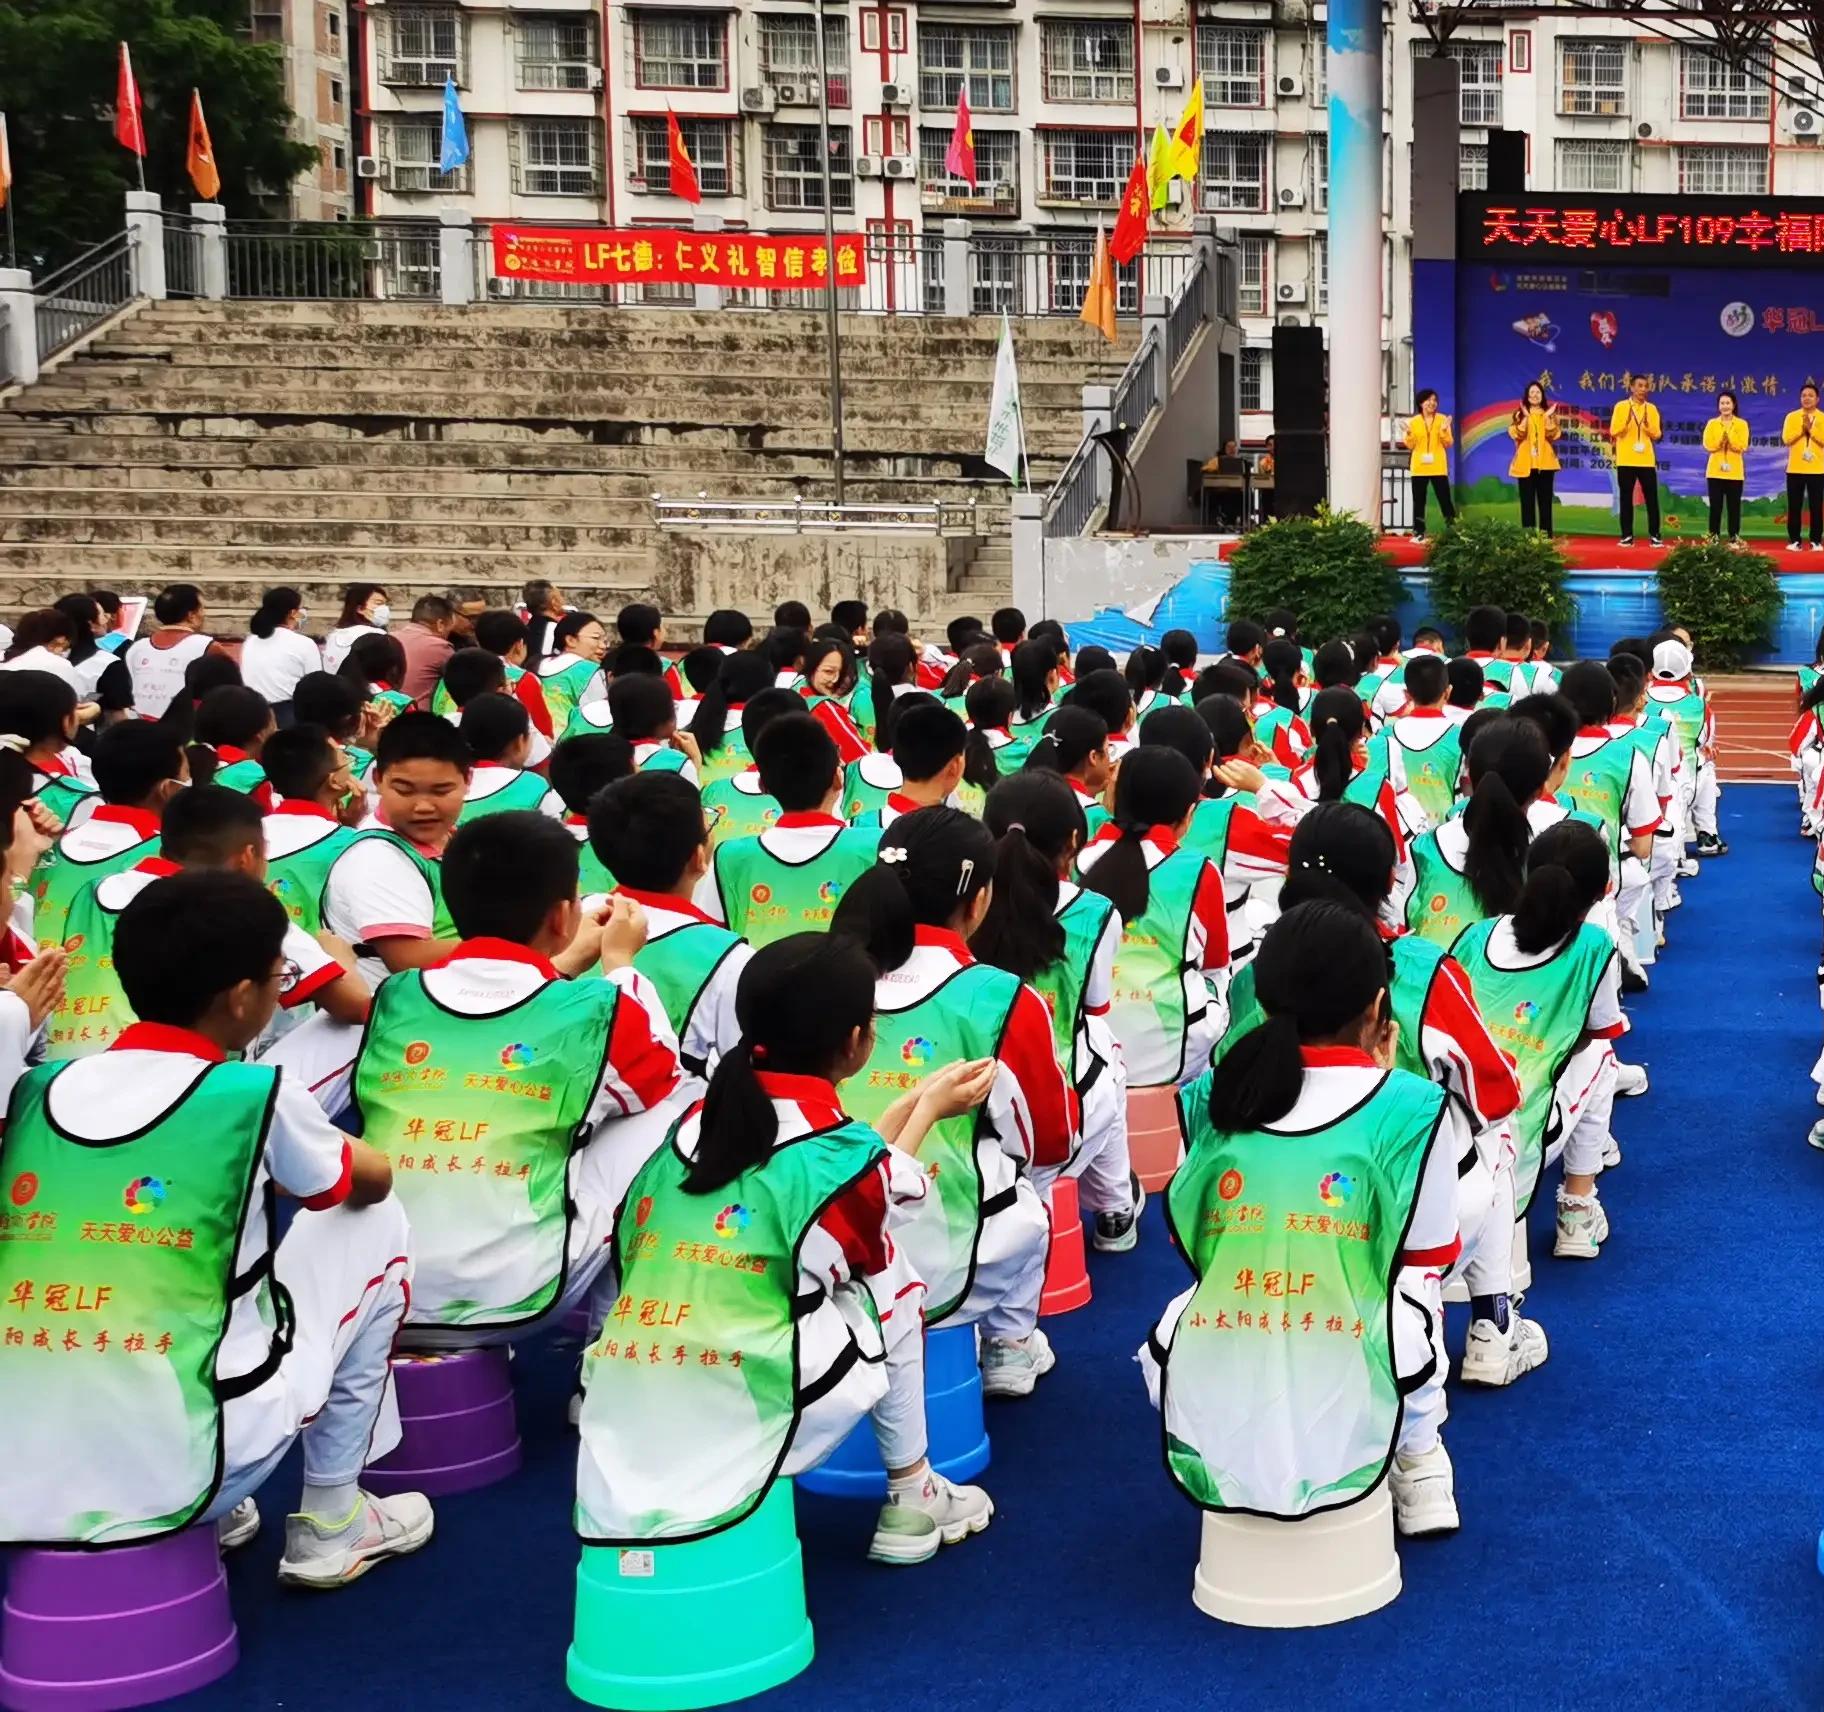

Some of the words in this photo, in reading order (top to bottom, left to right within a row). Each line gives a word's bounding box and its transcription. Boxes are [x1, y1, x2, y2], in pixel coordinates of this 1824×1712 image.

[403, 1117, 489, 1143] 华冠LF
[386, 1152, 531, 1181] 阳成长手拉手
[79, 1220, 196, 1250] 天天爱心公益
[1283, 1212, 1372, 1242] 天天爱心公益
[8, 1279, 113, 1313] 华冠LF
[1233, 1267, 1318, 1299] 华冠LF
[613, 1294, 693, 1327] 华冠LF
[1189, 1309, 1366, 1340] 小太阳成长手拉手
